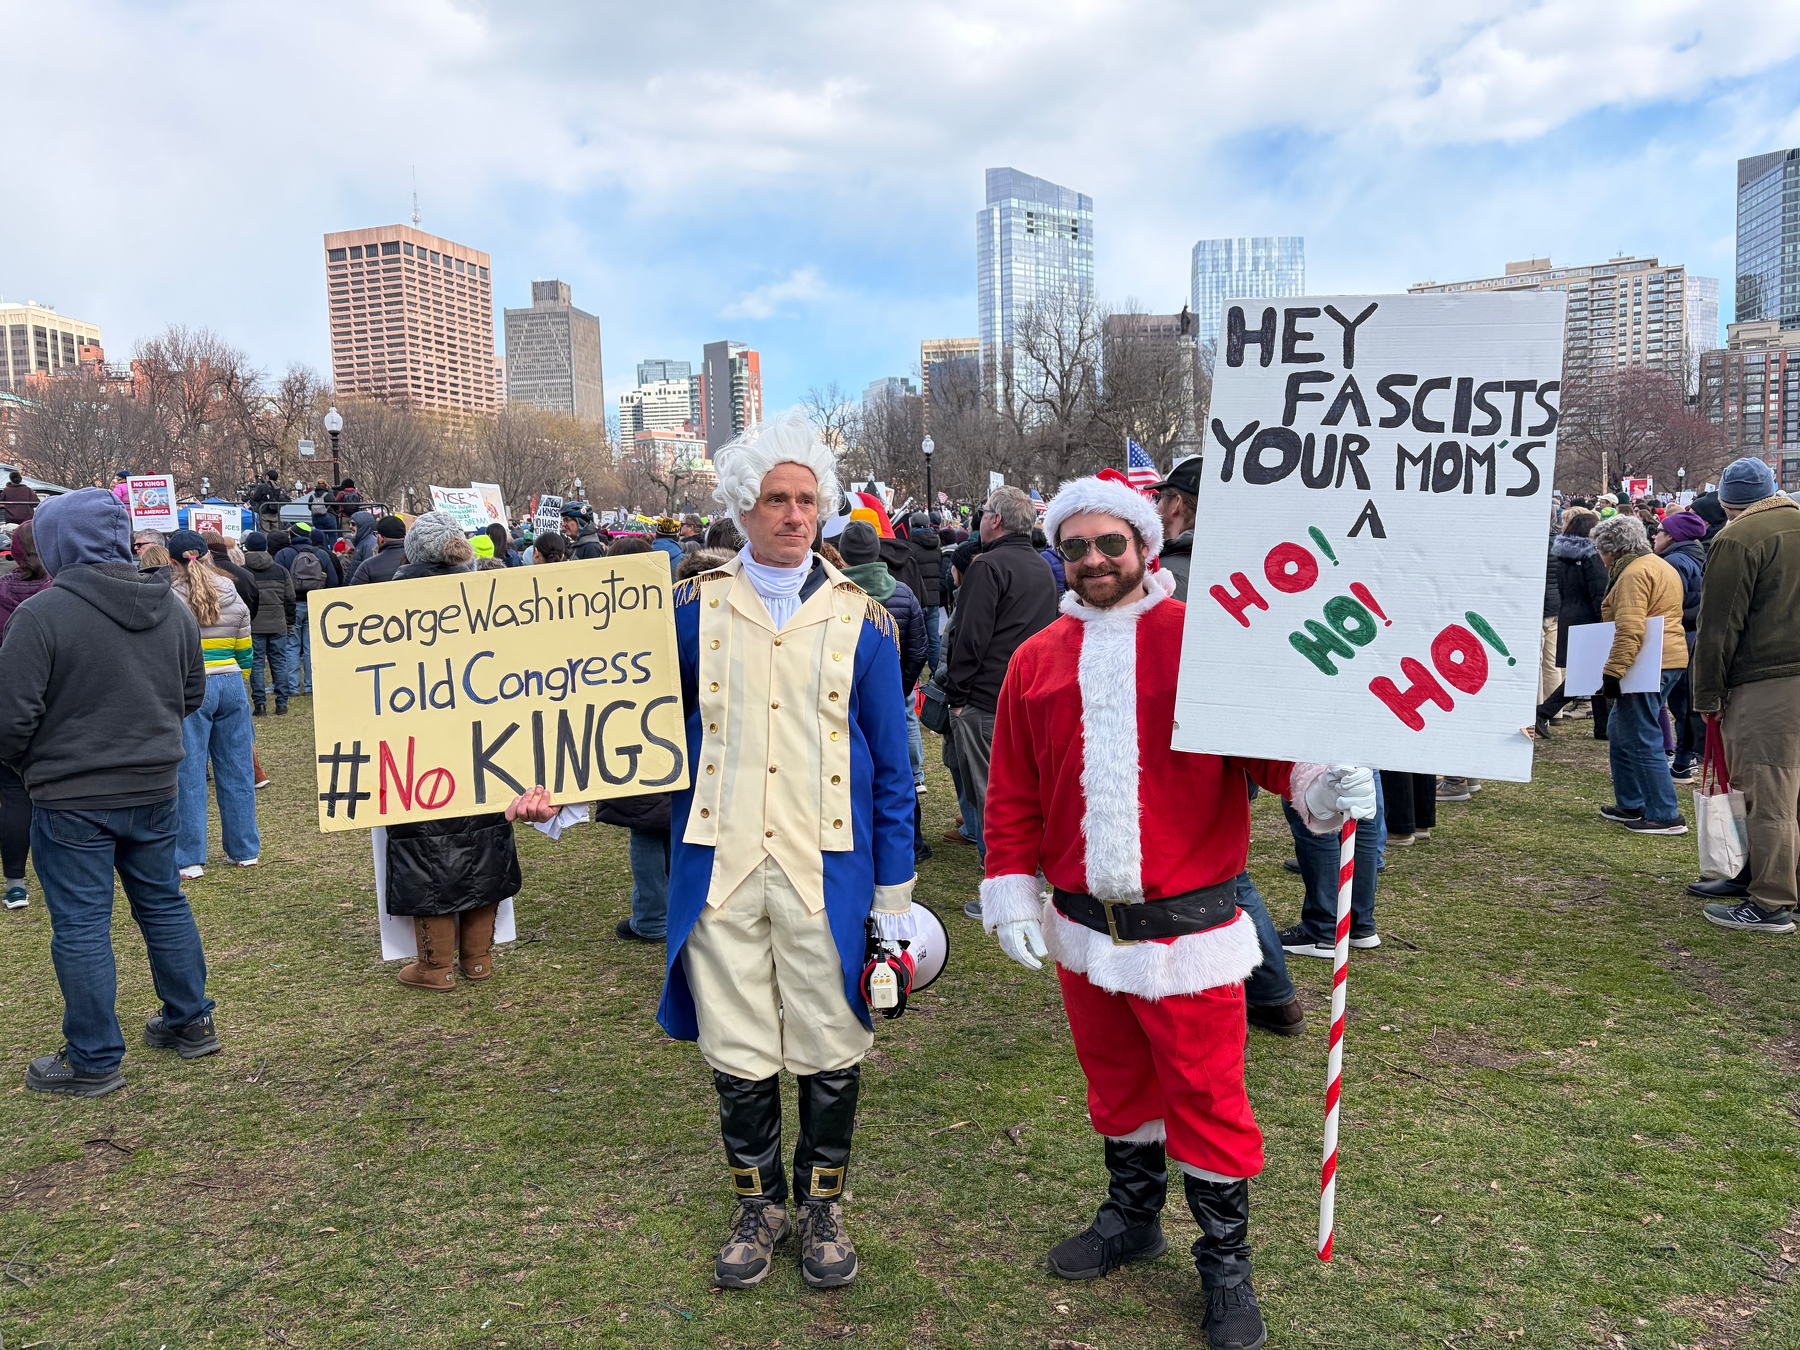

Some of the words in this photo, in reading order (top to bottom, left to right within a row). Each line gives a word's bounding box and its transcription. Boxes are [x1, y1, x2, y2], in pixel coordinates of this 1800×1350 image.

[1226, 302, 1378, 369] HEY
[1282, 371, 1560, 437] FASCISTS
[144, 480, 166, 488] KINGS
[1211, 418, 1371, 491] YOUR
[1396, 439, 1547, 497] MOM'S
[1347, 498, 1387, 539] A
[320, 601, 461, 647] George
[459, 569, 663, 635] Washington
[1209, 525, 1340, 628] HO!
[1288, 581, 1393, 677] HO!
[355, 657, 456, 716] Told
[461, 650, 653, 706] Congress
[1368, 610, 1517, 732] HO!
[471, 694, 684, 805] KINGS
